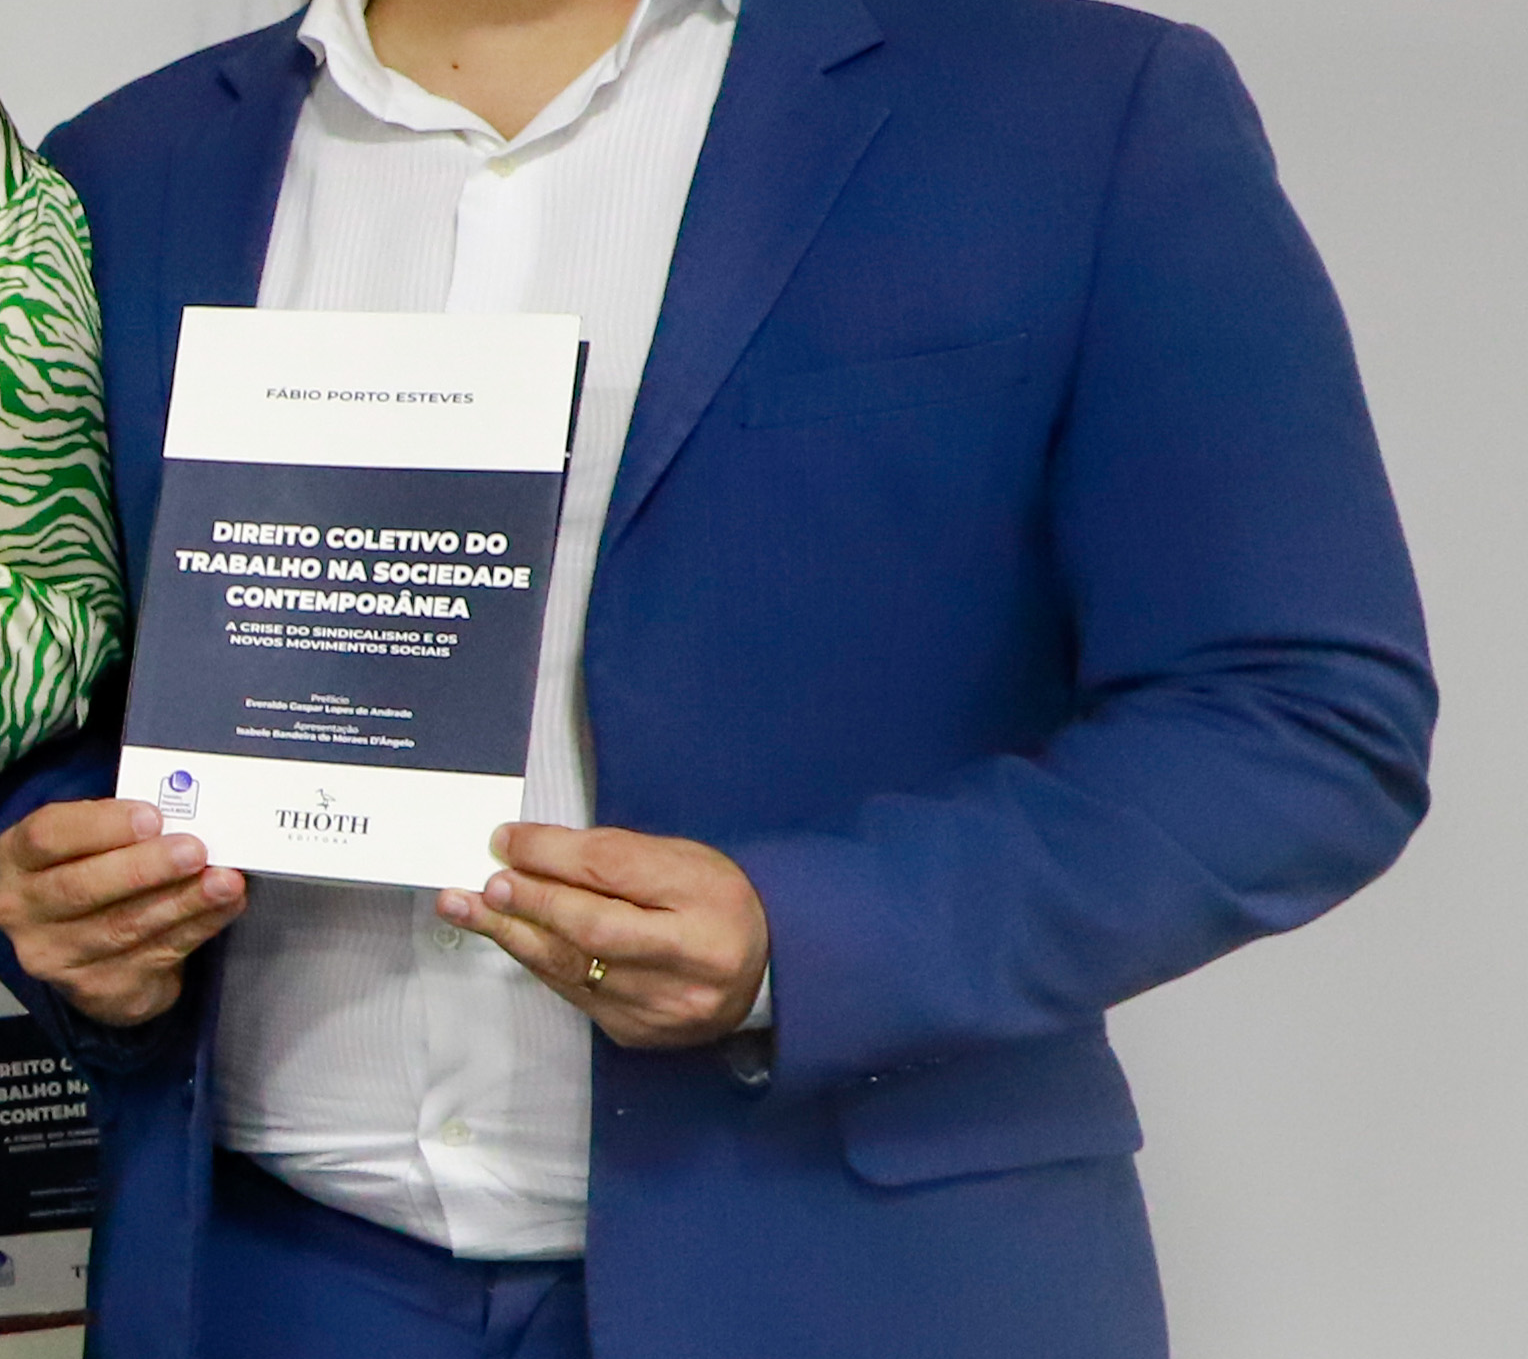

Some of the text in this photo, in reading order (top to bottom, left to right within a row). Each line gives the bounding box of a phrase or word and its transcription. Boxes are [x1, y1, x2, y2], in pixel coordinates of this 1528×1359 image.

[265, 388, 474, 404] FÁBIO PORTO ESTEVES
[212, 520, 508, 555] DIREITO COLETIVO DO
[175, 549, 531, 589] TRABALHO NA SOCIEDADE
[225, 585, 470, 619] CONTEMPORÂNEA
[224, 621, 458, 644] A CRISE DO SINDICALISMO E OS
[229, 633, 450, 657] NOVOS MOVIMENTOS SOCIAIS
[276, 810, 368, 834] THOTH
